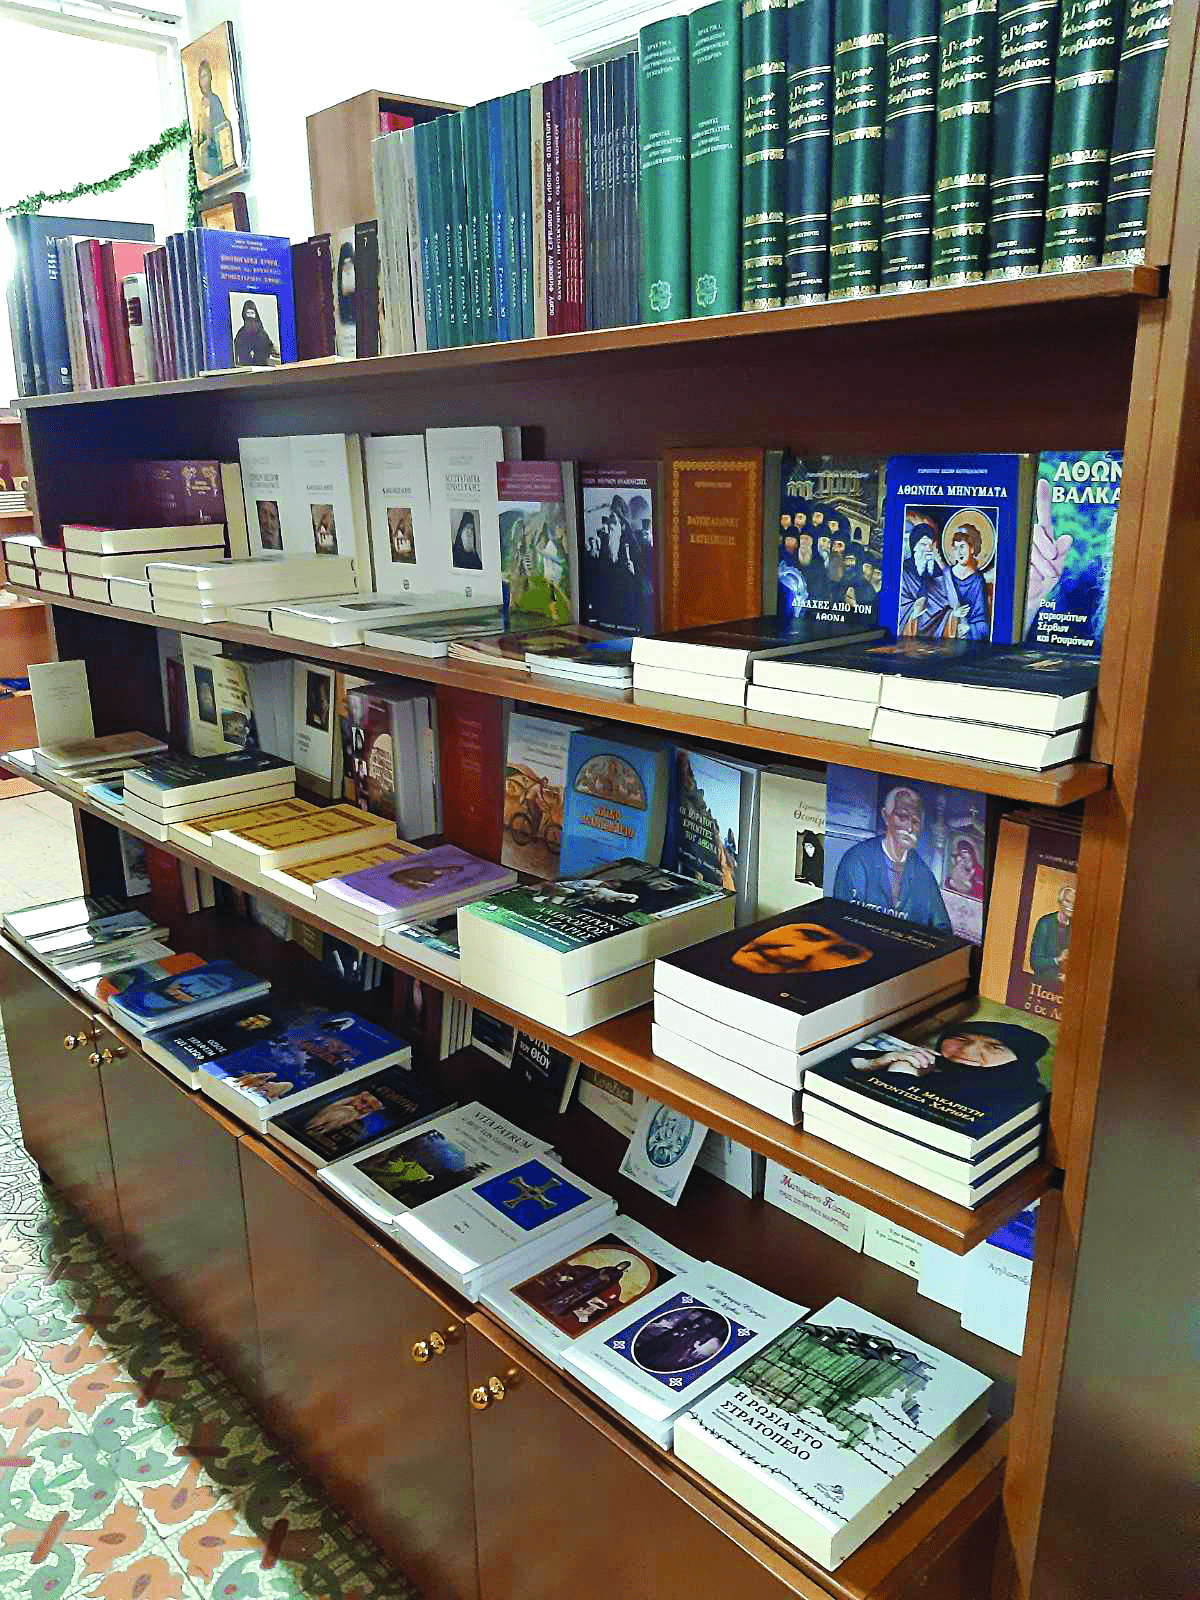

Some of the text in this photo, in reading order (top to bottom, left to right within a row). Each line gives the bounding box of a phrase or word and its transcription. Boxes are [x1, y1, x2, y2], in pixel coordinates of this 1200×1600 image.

[897, 485, 1008, 498] ΑΘΩΝΙΚΑ ΜΗΝΥΜΑΤΑ
[832, 602, 851, 613] ΑΠΟ
[853, 604, 872, 615] ΤΟΝ
[1039, 598, 1056, 610] Ροή
[1050, 634, 1095, 647] Ρουμάνων
[531, 914, 596, 941] ΛΑΖΑΡΗΣ
[576, 913, 620, 932] ΓΕΡΩΝ
[733, 1391, 748, 1402] Η
[746, 1399, 790, 1431] ΡΩΣΙΑ
[792, 1427, 824, 1450] ΣΤΟ
[719, 1400, 811, 1461] ΣΤΡΑΤΟΠΕΔΟ
